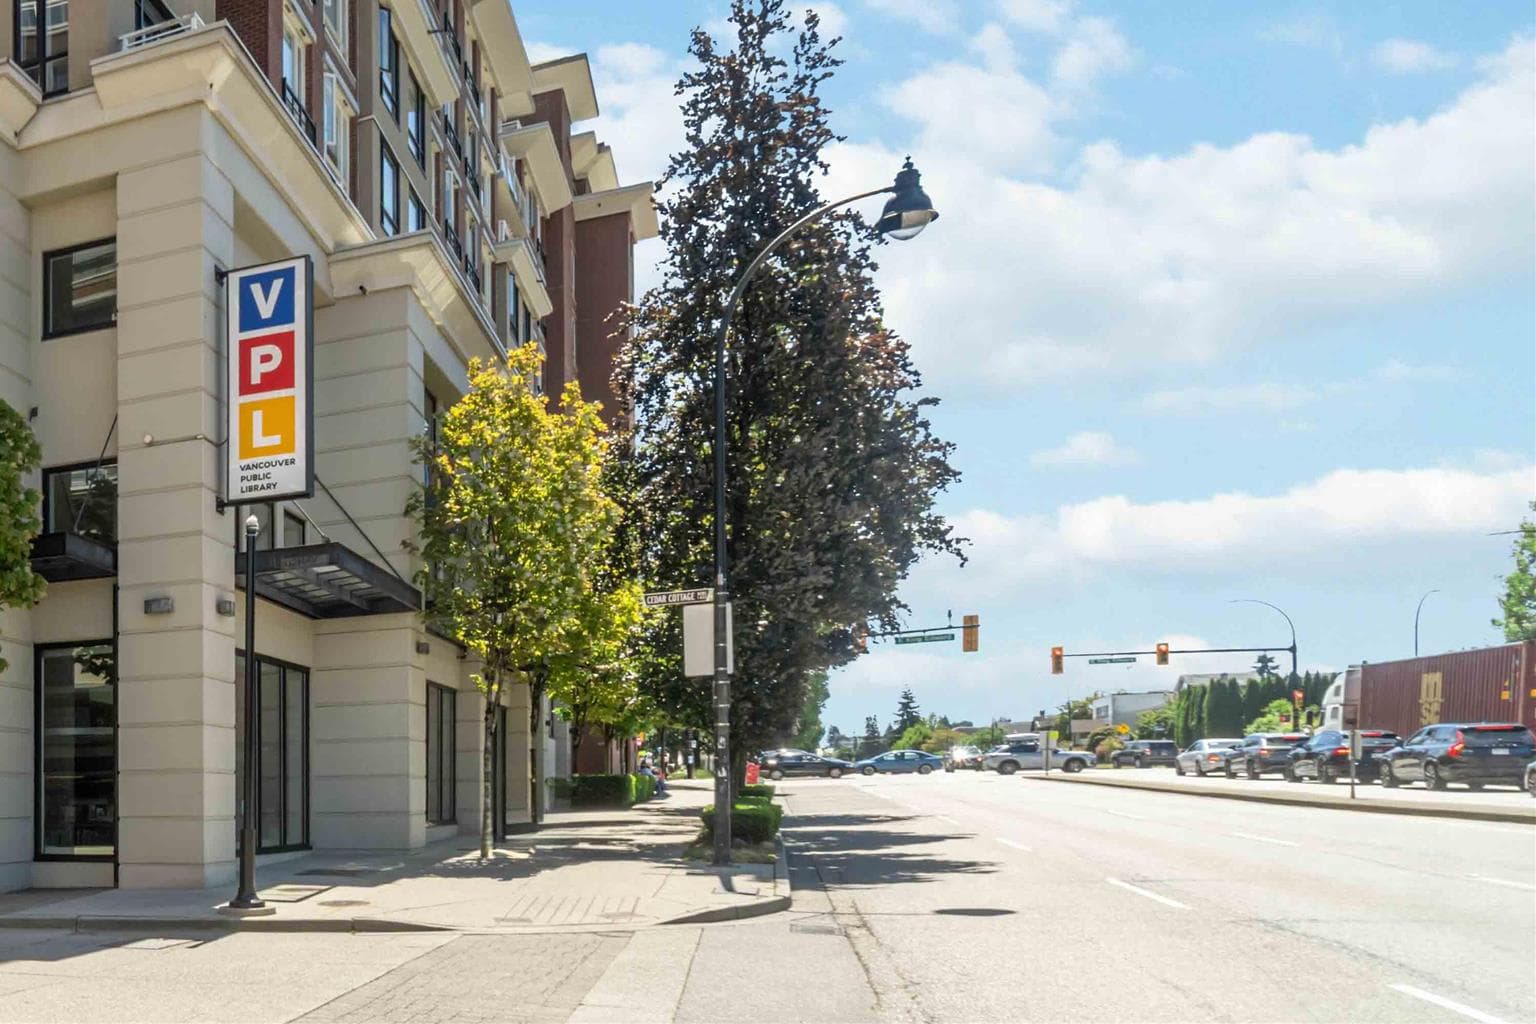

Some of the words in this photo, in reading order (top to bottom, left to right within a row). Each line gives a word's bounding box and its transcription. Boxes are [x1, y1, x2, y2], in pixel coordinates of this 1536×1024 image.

[240, 458, 296, 471] VANCOUVER
[240, 472, 271, 482] PUBLIC
[240, 482, 278, 493] LIBRARY
[647, 595, 667, 604] CEDAR
[668, 592, 695, 601] COTTAGE
